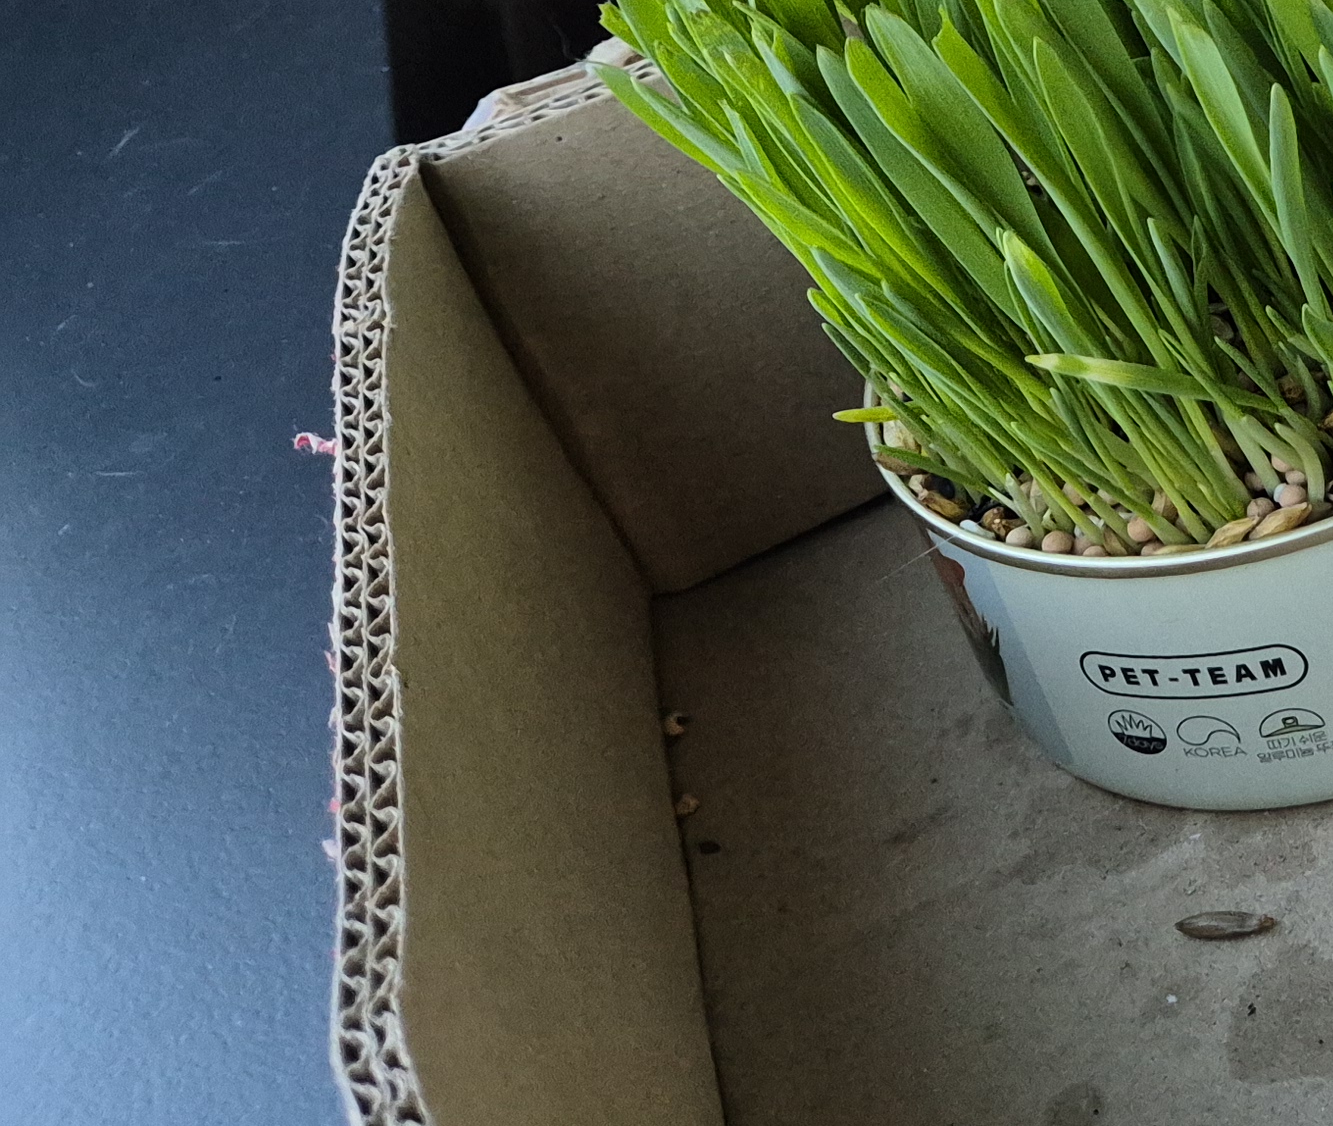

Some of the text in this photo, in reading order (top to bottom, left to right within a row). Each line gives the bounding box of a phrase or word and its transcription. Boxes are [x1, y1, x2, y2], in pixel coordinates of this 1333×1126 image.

[1097, 656, 1288, 687] PET-TEAM
[1267, 736, 1297, 750] 따기
[1183, 746, 1248, 758] KOREA
